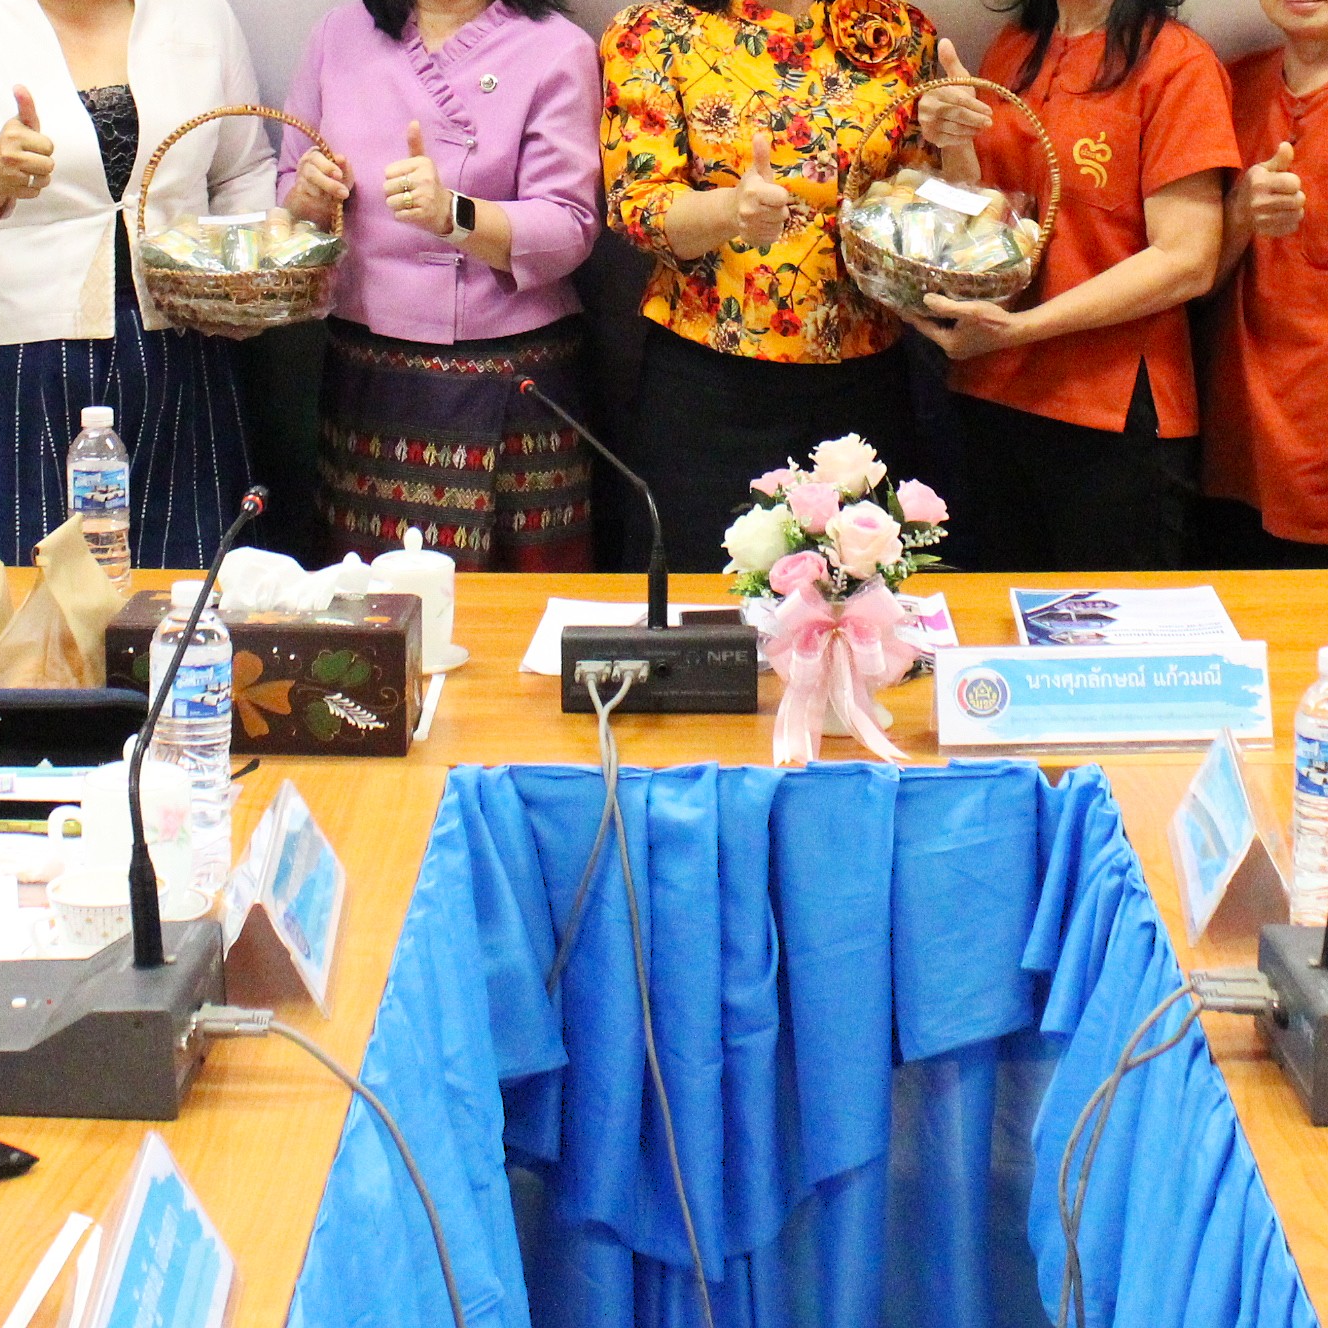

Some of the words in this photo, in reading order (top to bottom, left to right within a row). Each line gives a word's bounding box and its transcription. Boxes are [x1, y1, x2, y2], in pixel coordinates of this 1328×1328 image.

[707, 650, 748, 665] NPE
[1153, 663, 1221, 687] แก้วมณี
